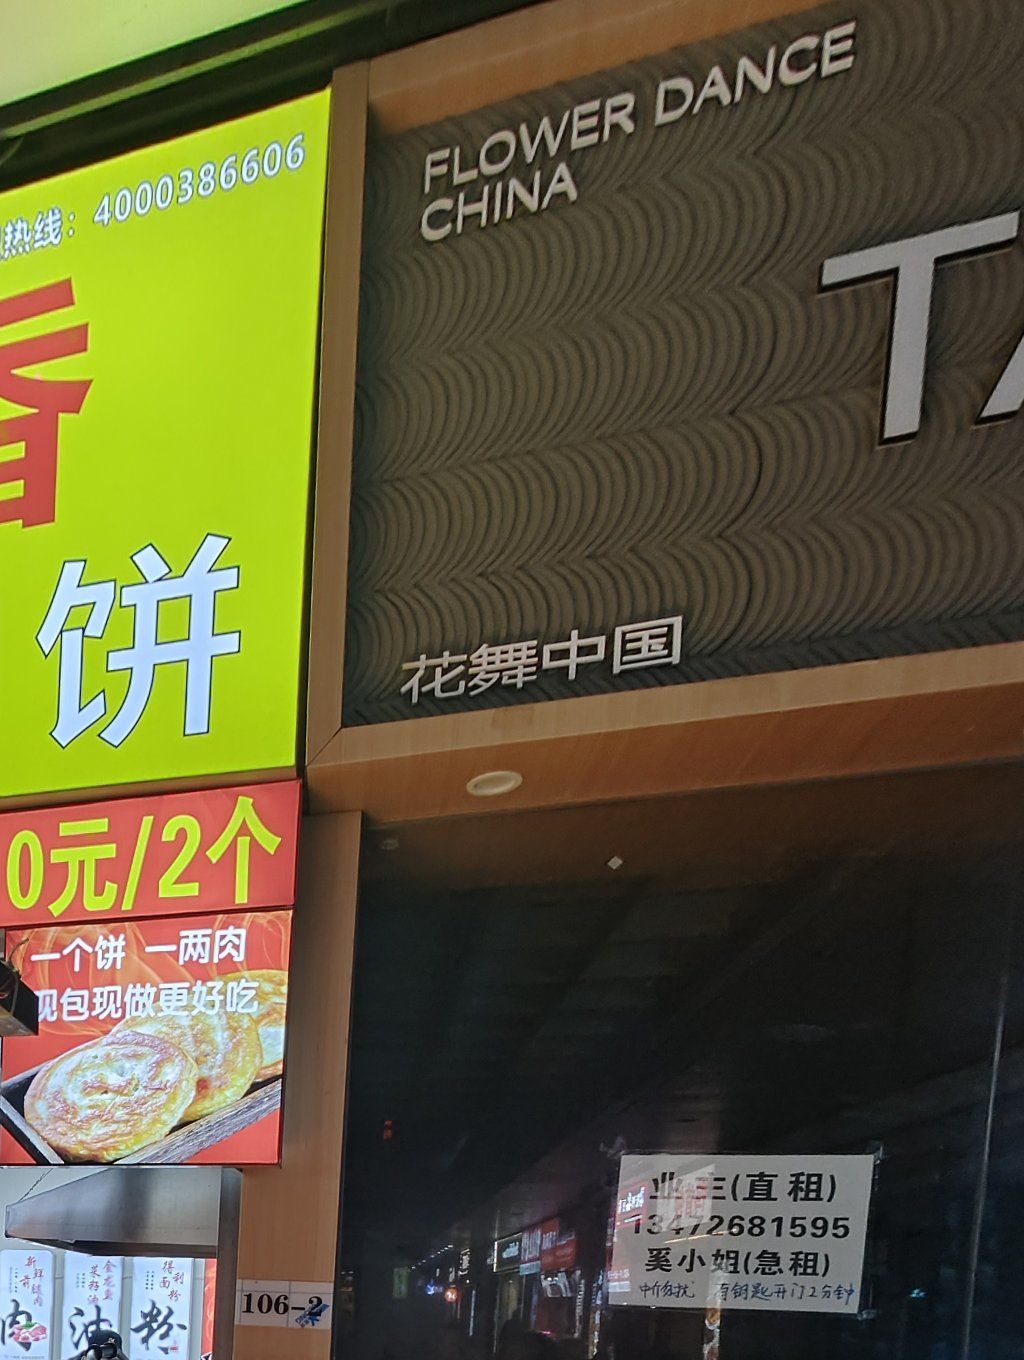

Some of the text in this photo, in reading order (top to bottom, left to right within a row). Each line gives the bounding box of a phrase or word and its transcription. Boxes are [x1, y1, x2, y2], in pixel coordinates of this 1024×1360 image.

[422, 22, 857, 194] FLOWER DANCE
[420, 162, 578, 242] CHINA
[399, 615, 684, 704] 花舞中国
